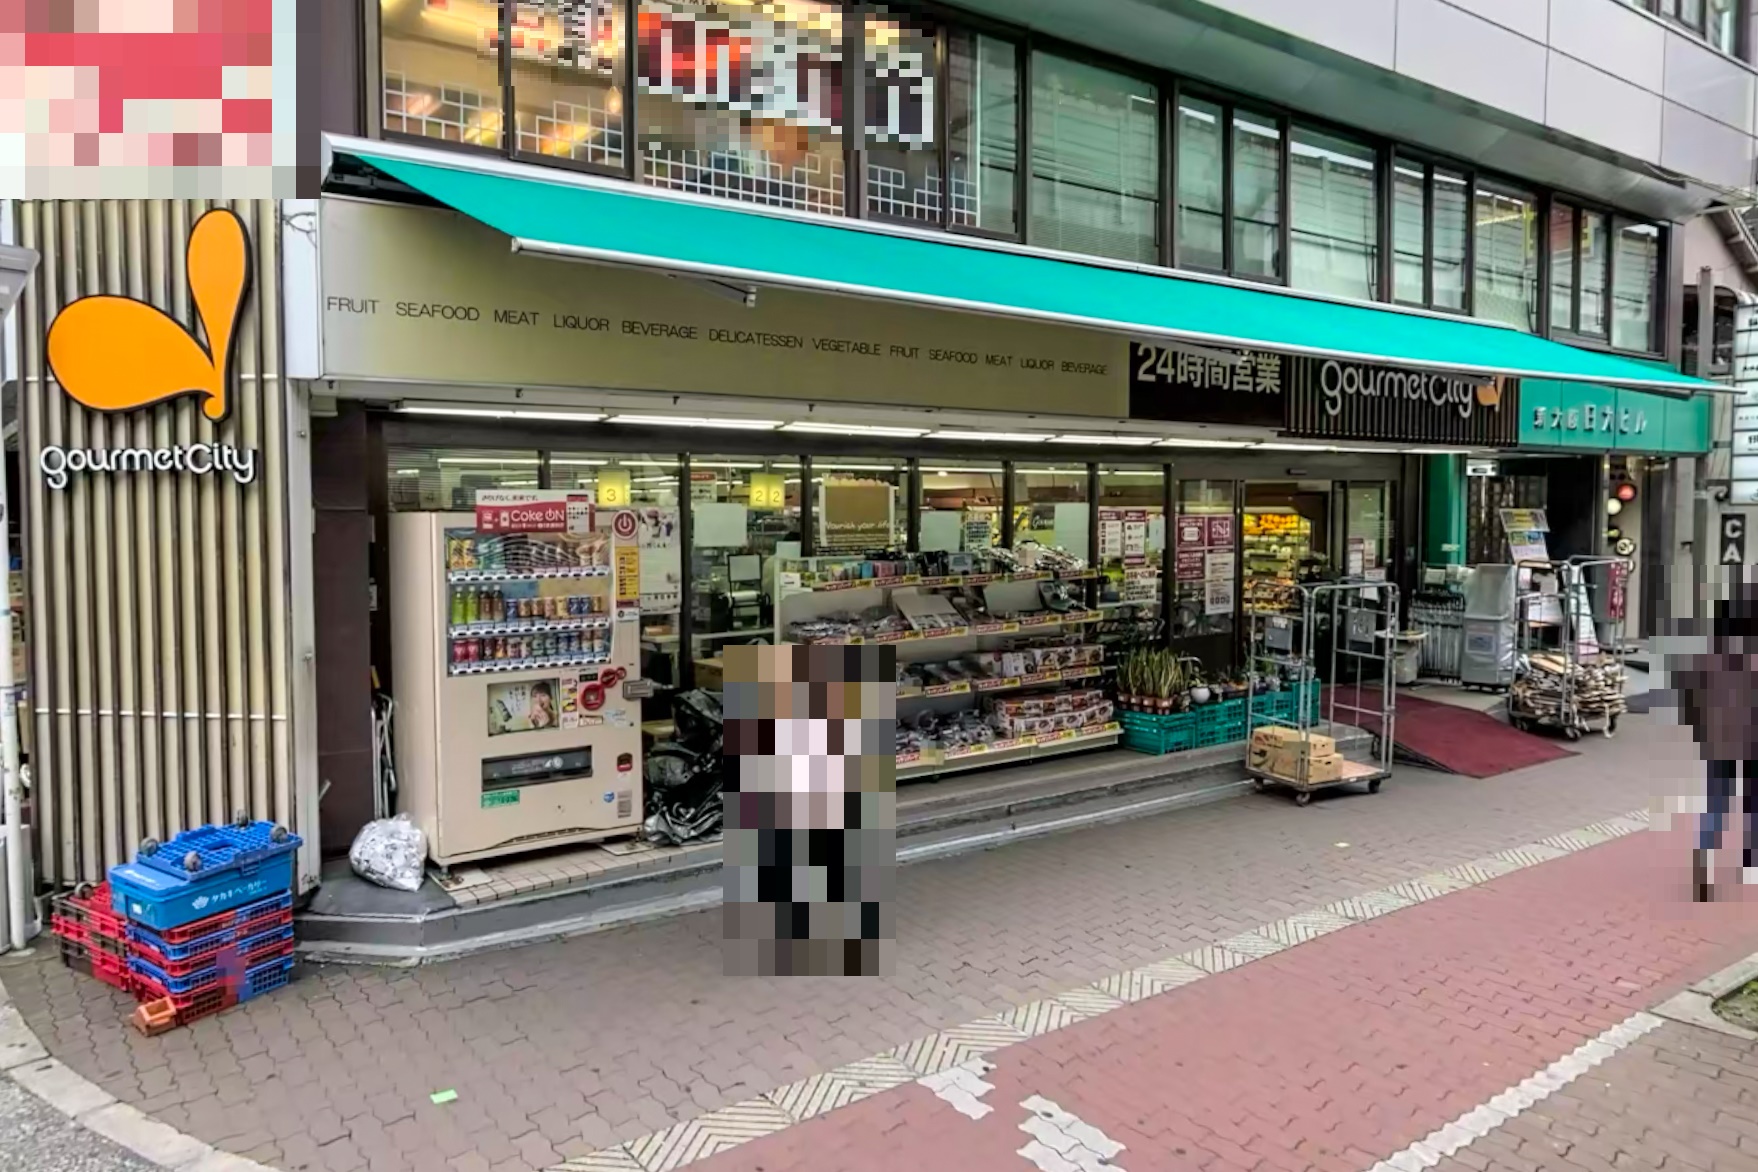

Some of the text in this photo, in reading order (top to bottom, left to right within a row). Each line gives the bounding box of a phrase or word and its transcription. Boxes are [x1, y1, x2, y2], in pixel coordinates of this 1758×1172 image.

[326, 296, 1109, 376] FRUIT SEAFOOD MEAT LIQUOR BEVERAGE DELICATESSEN VEGETABLE FRUIT SEAFOOD MEAT LIQUOR BEVERAGE
[1137, 345, 1282, 395] 24時間営業
[1321, 360, 1473, 419] gourmetCity
[40, 441, 258, 489] gourmetCity
[606, 489, 617, 502] 3
[755, 489, 764, 503] 2
[772, 490, 781, 503] 2
[510, 509, 544, 523] Coke
